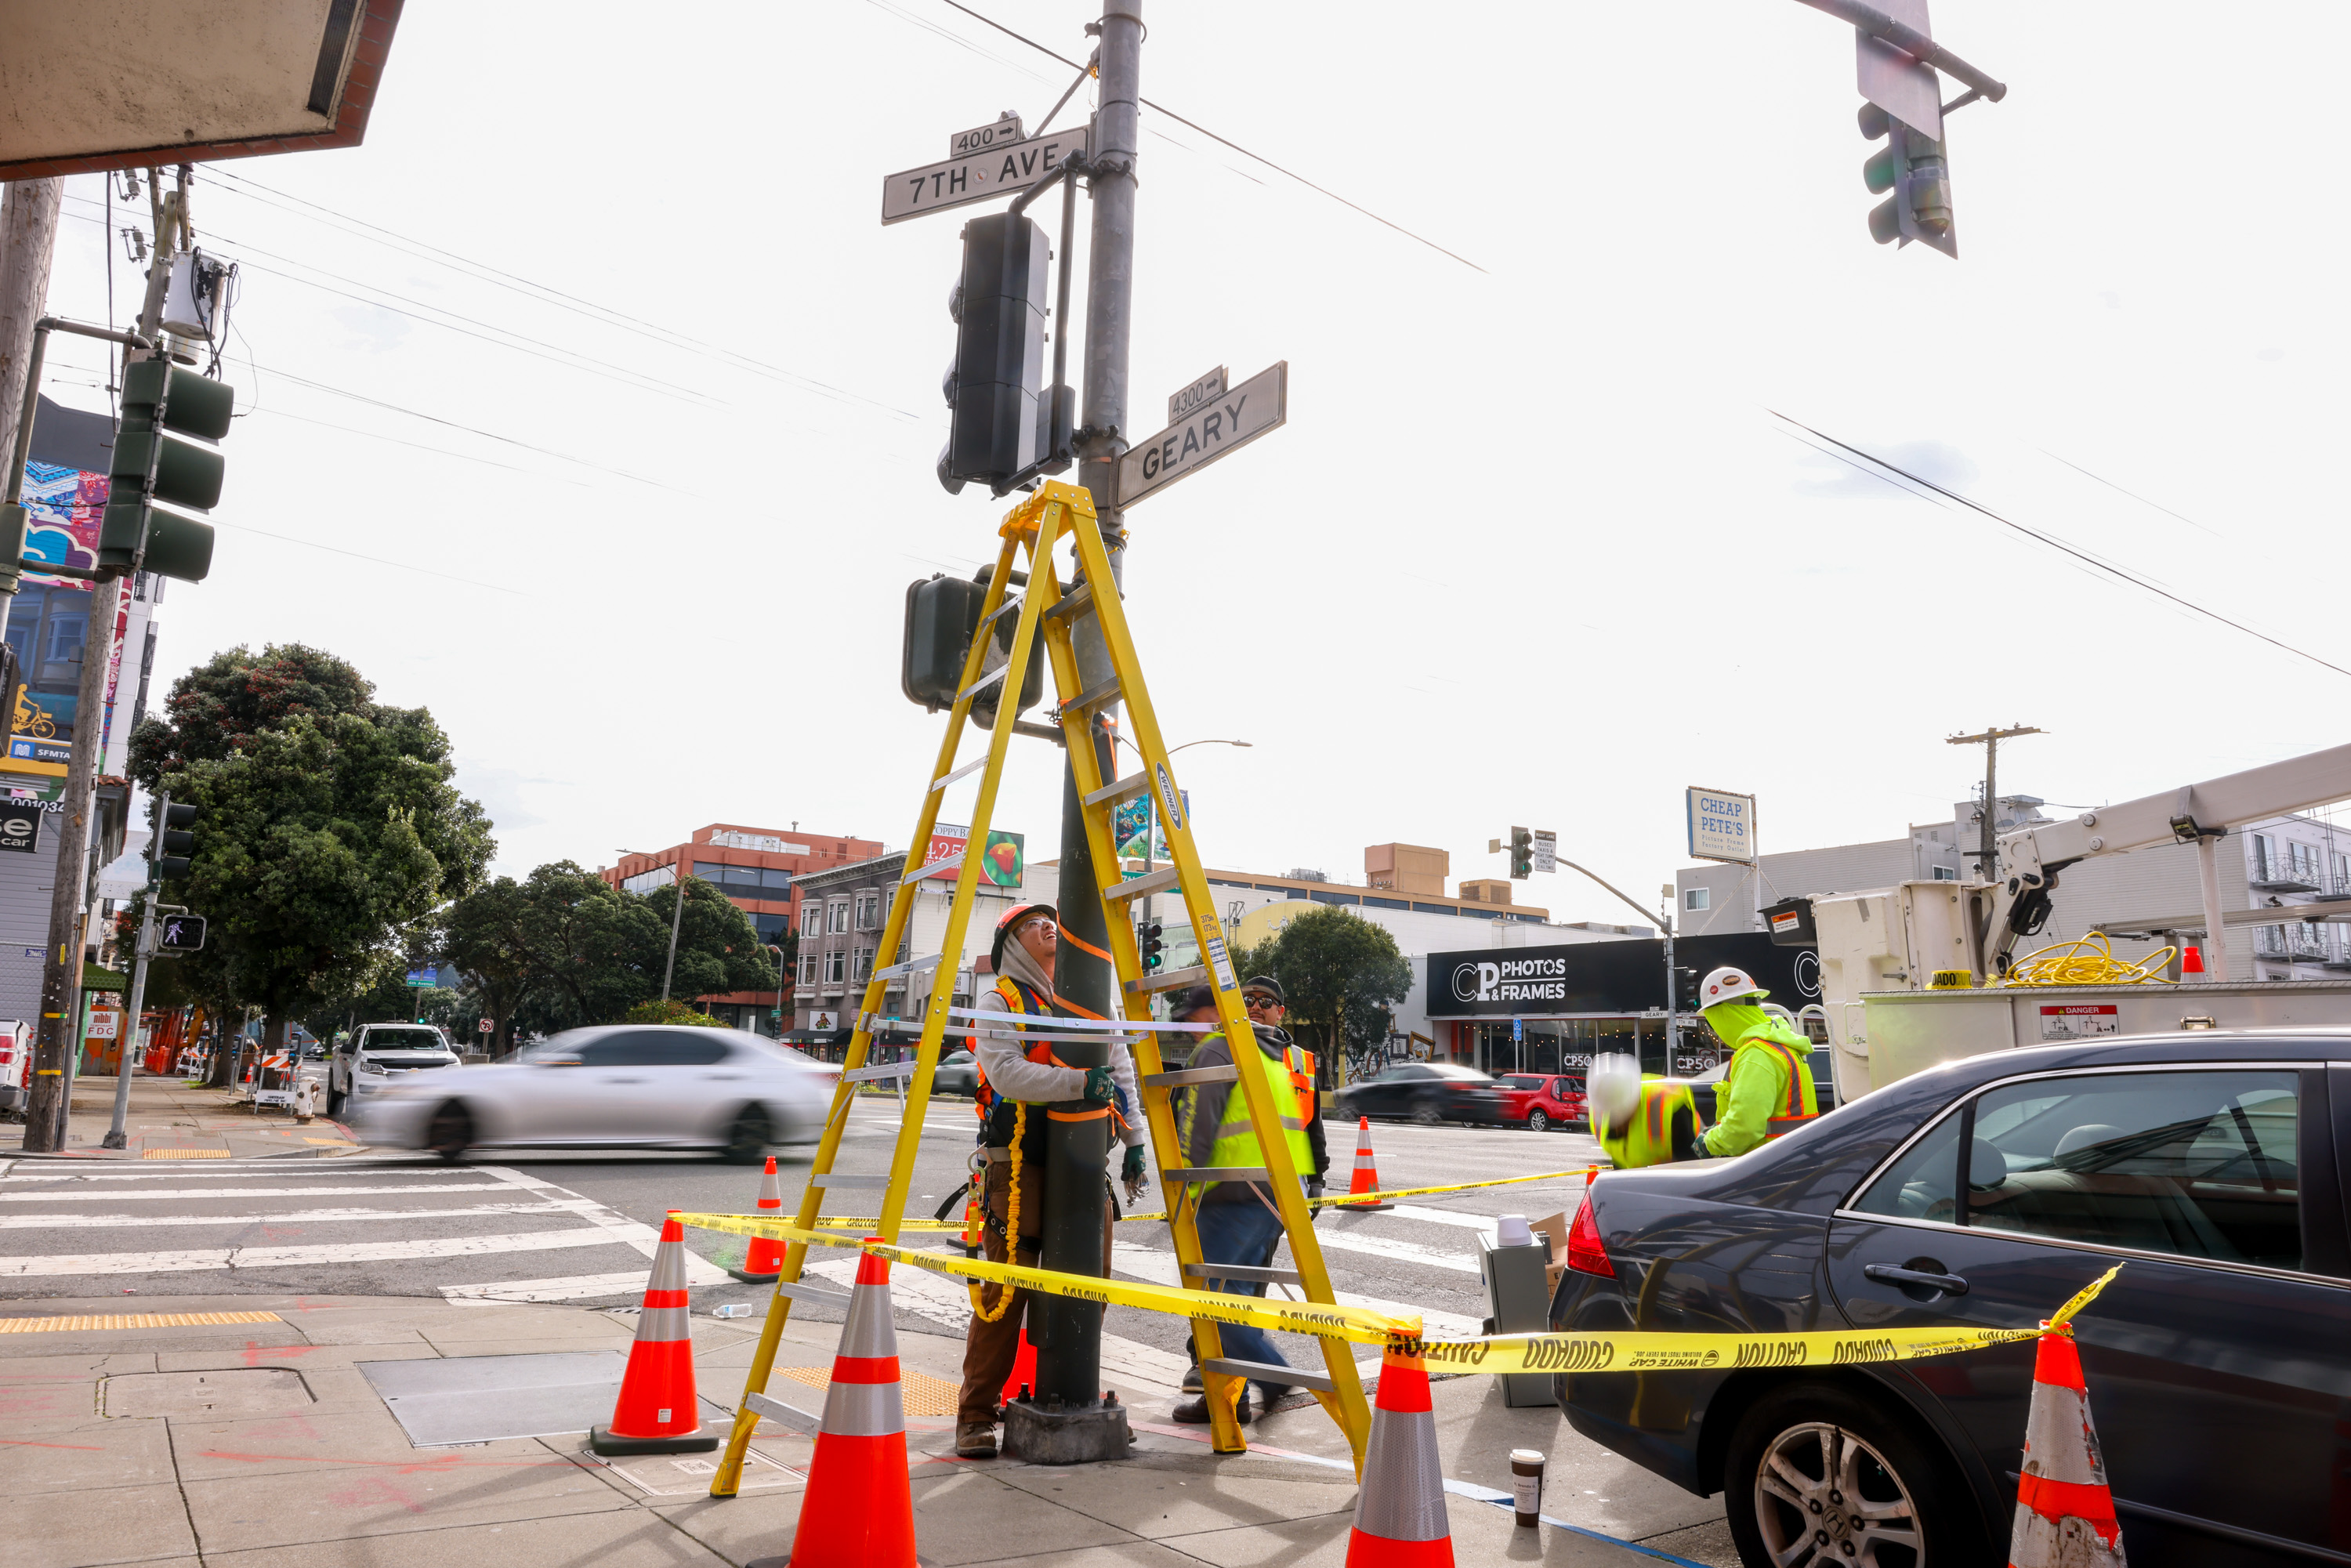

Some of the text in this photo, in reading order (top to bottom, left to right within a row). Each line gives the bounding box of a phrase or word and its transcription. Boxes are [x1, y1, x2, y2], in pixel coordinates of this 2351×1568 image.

[957, 128, 993, 150] 400
[909, 143, 1060, 204] 7TH AVE
[1172, 382, 1204, 415] 4300
[1143, 393, 1248, 480] GEARY
[38, 748, 71, 759] SFMTA
[1160, 775, 1178, 817] WERNER
[1701, 797, 1742, 817] CHEAP
[0, 818, 33, 836] e
[1701, 817, 1744, 836] PETE'S
[926, 841, 967, 861] 4.25
[1702, 842, 1745, 853] Factory Outlet
[1501, 958, 1566, 977] PHOTOS
[1452, 961, 1500, 1002] CP
[1491, 983, 1566, 1001] & FRAMES
[93, 1012, 112, 1023] nibbi
[1563, 1055, 1592, 1066] CP50
[1677, 1058, 1716, 1070] CP50
[1521, 1338, 1615, 1370] CUIDADO
[1731, 1340, 1807, 1368] CAUTION
[1834, 1338, 1899, 1365] CUIDADO
[1657, 1359, 1699, 1367] WHITE
